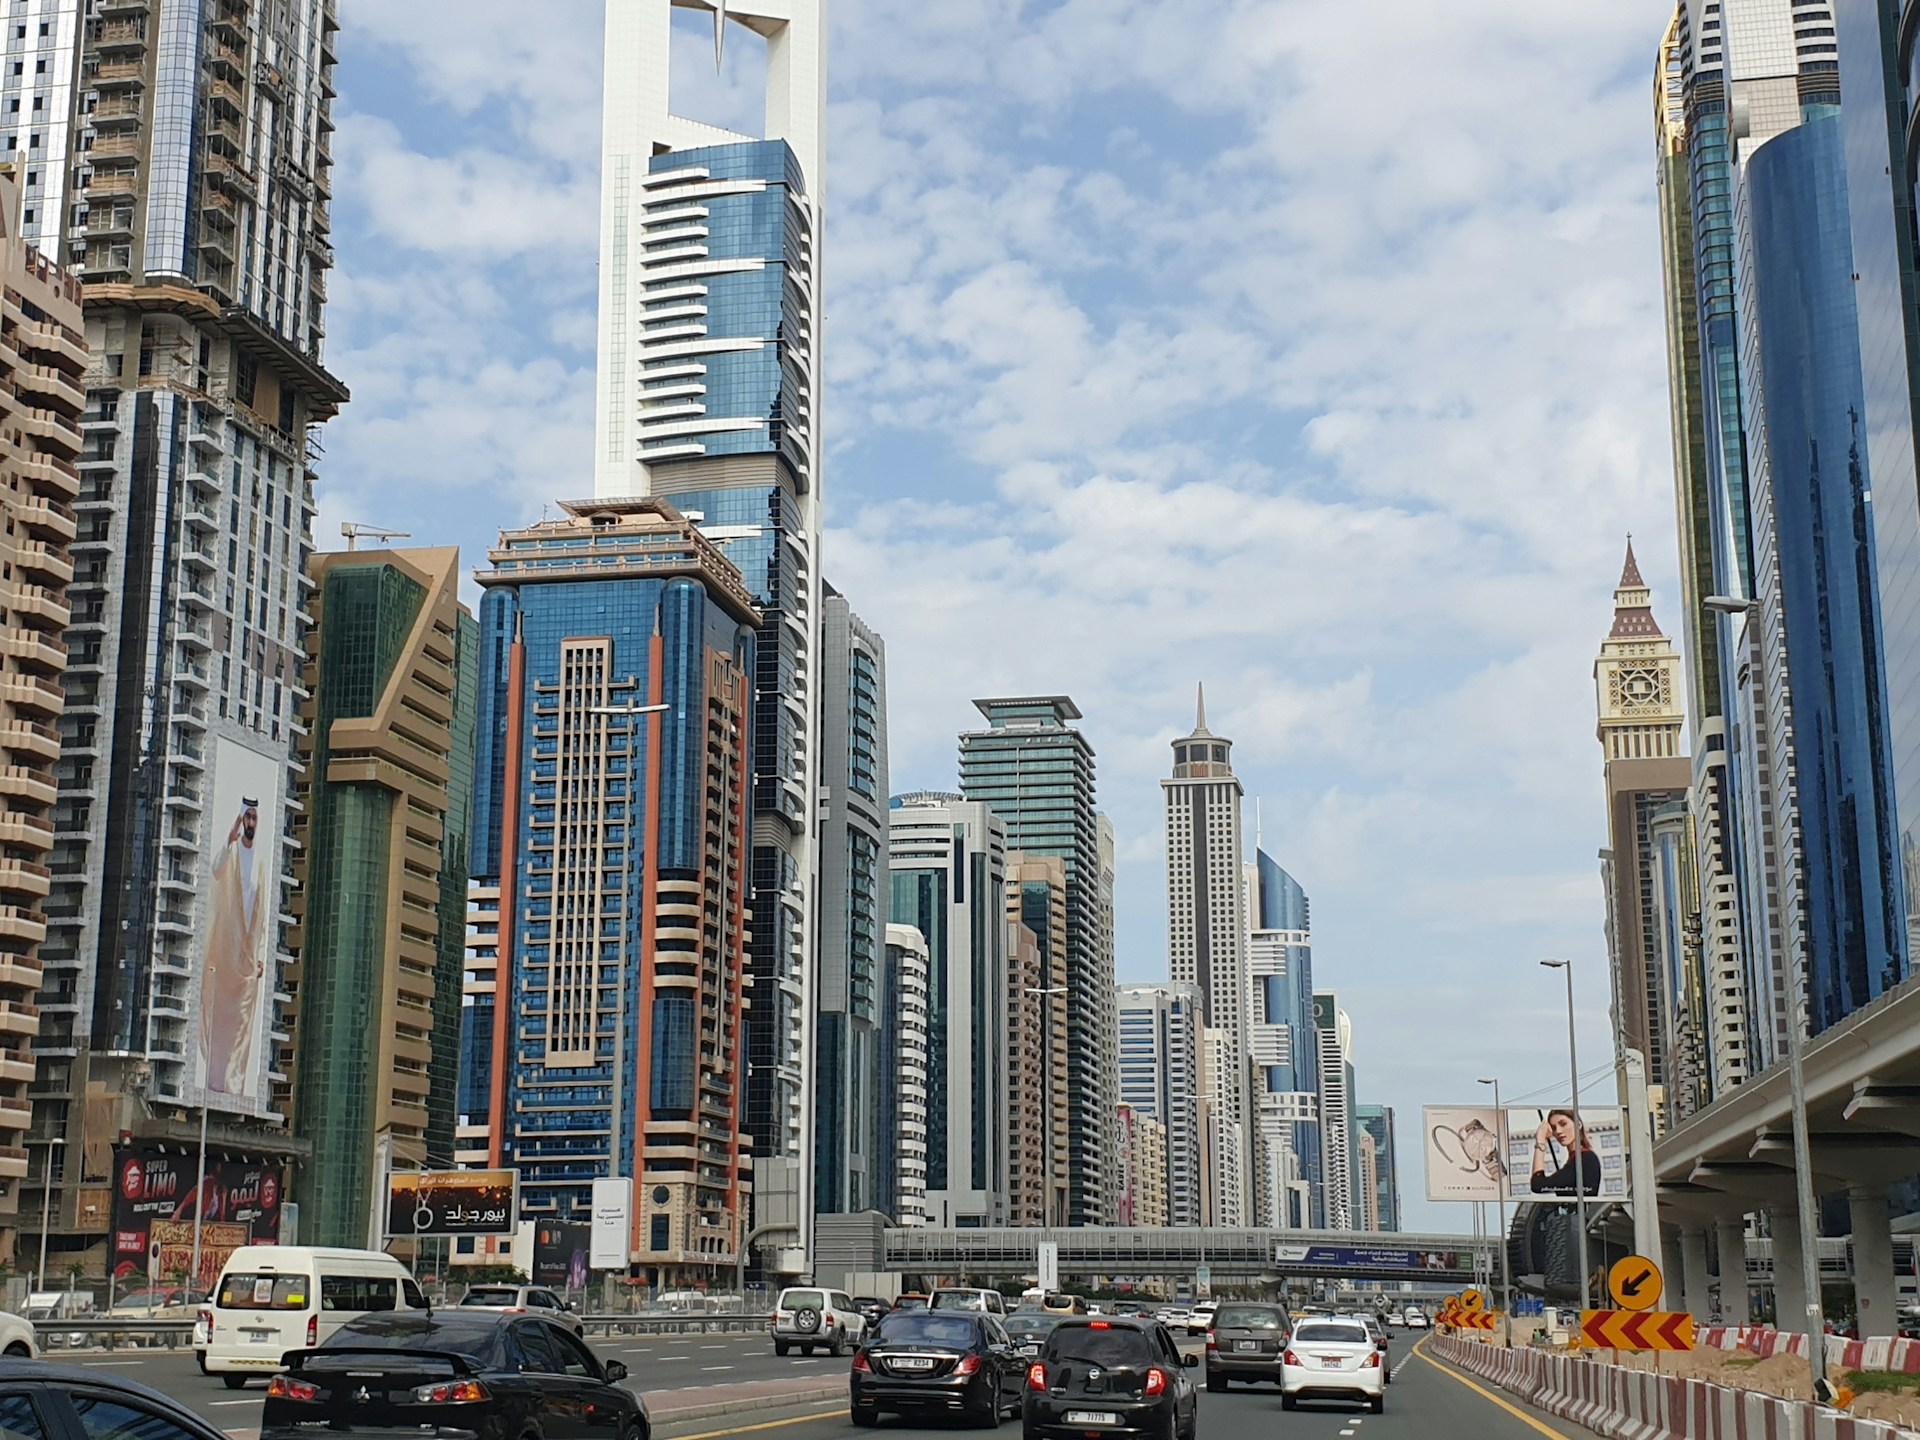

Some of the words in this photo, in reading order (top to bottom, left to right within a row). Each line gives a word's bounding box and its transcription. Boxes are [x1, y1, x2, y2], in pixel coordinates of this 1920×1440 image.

[145, 1160, 168, 1174] SUPER
[143, 1171, 177, 1198] LIMO
[230, 1180, 260, 1210] ليمو
[1087, 1413, 1105, 1421] 71775
